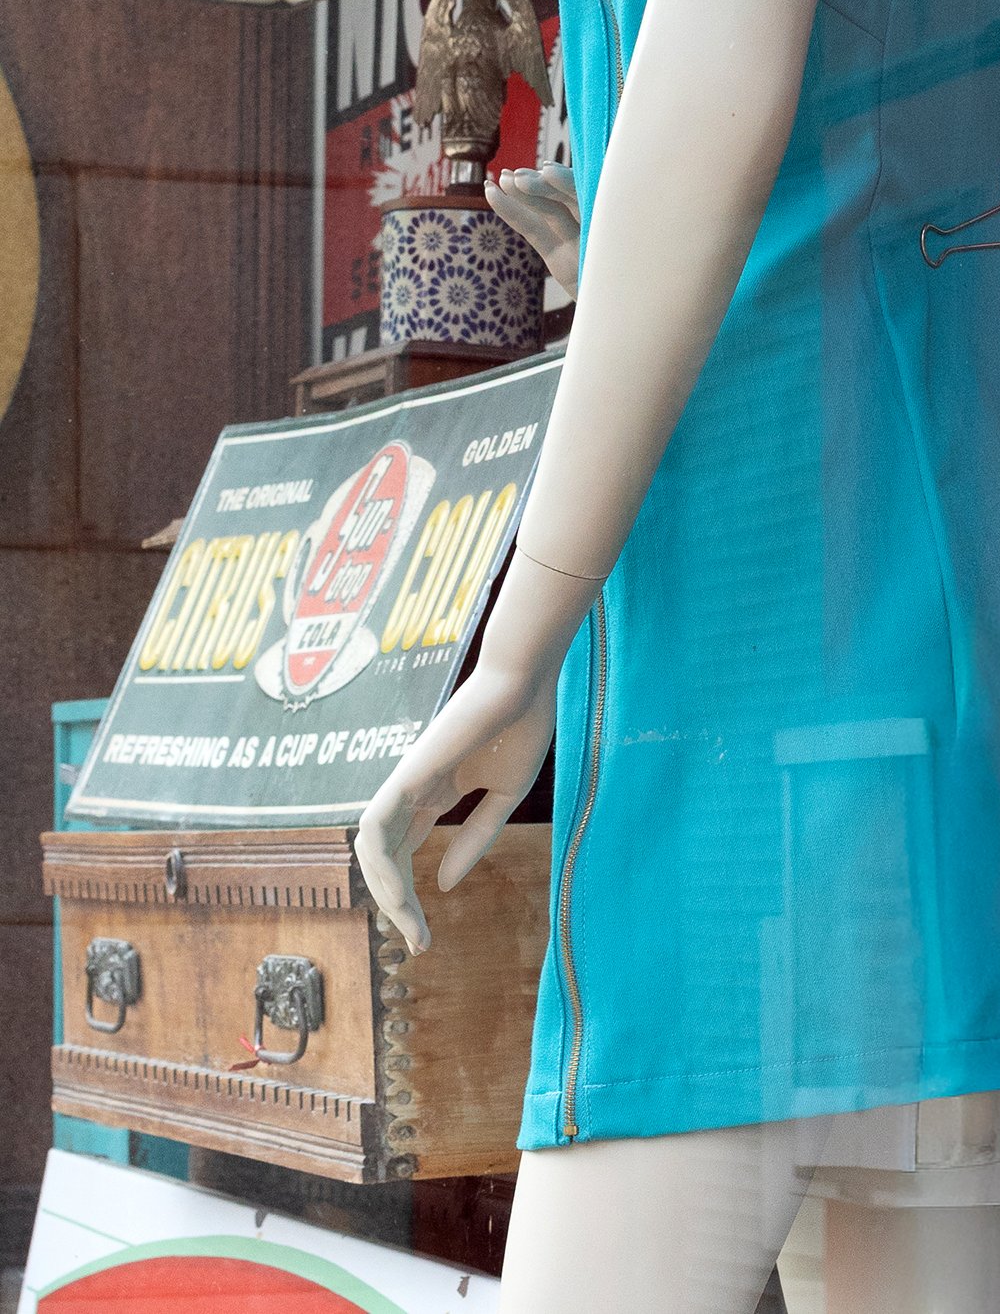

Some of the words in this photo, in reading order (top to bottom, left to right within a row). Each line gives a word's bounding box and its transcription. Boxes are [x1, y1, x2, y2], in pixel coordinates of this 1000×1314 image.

[462, 422, 539, 467] GOLDEN
[216, 488, 248, 513] THE
[245, 478, 313, 510] ORIGINAL
[380, 482, 517, 654] COLA
[139, 529, 300, 671] CITRUS
[297, 619, 342, 650] COLA
[412, 646, 451, 670] DRINK
[103, 734, 230, 768] REFRESHING
[227, 736, 260, 769] AS
[258, 736, 280, 768] A
[275, 733, 318, 768] CUP
[317, 731, 349, 765] OF
[346, 721, 423, 763] COFFEE
